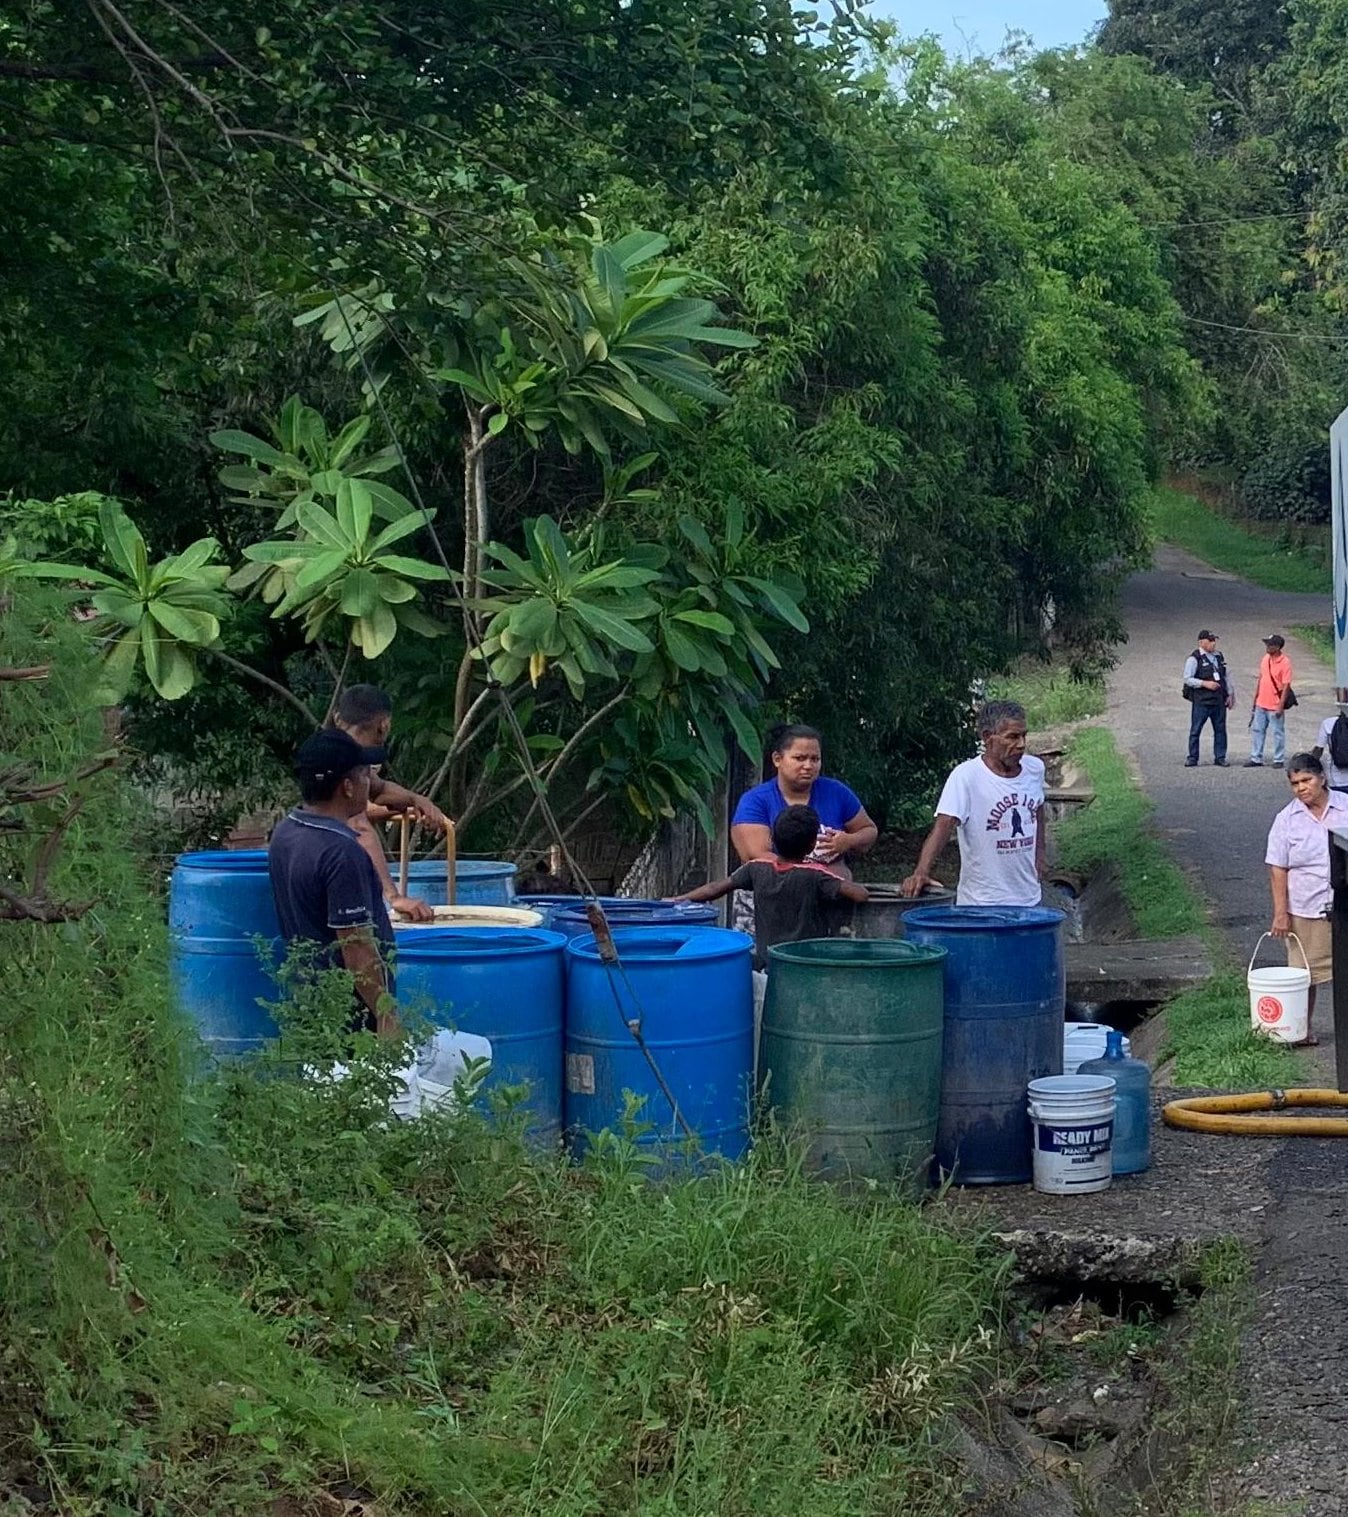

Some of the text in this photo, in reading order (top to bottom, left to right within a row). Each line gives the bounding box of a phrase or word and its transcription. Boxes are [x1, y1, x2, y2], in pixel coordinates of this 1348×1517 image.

[986, 793, 1018, 831] MOOSE
[997, 839, 1017, 849] NEW
[1053, 1130, 1091, 1145] READY
